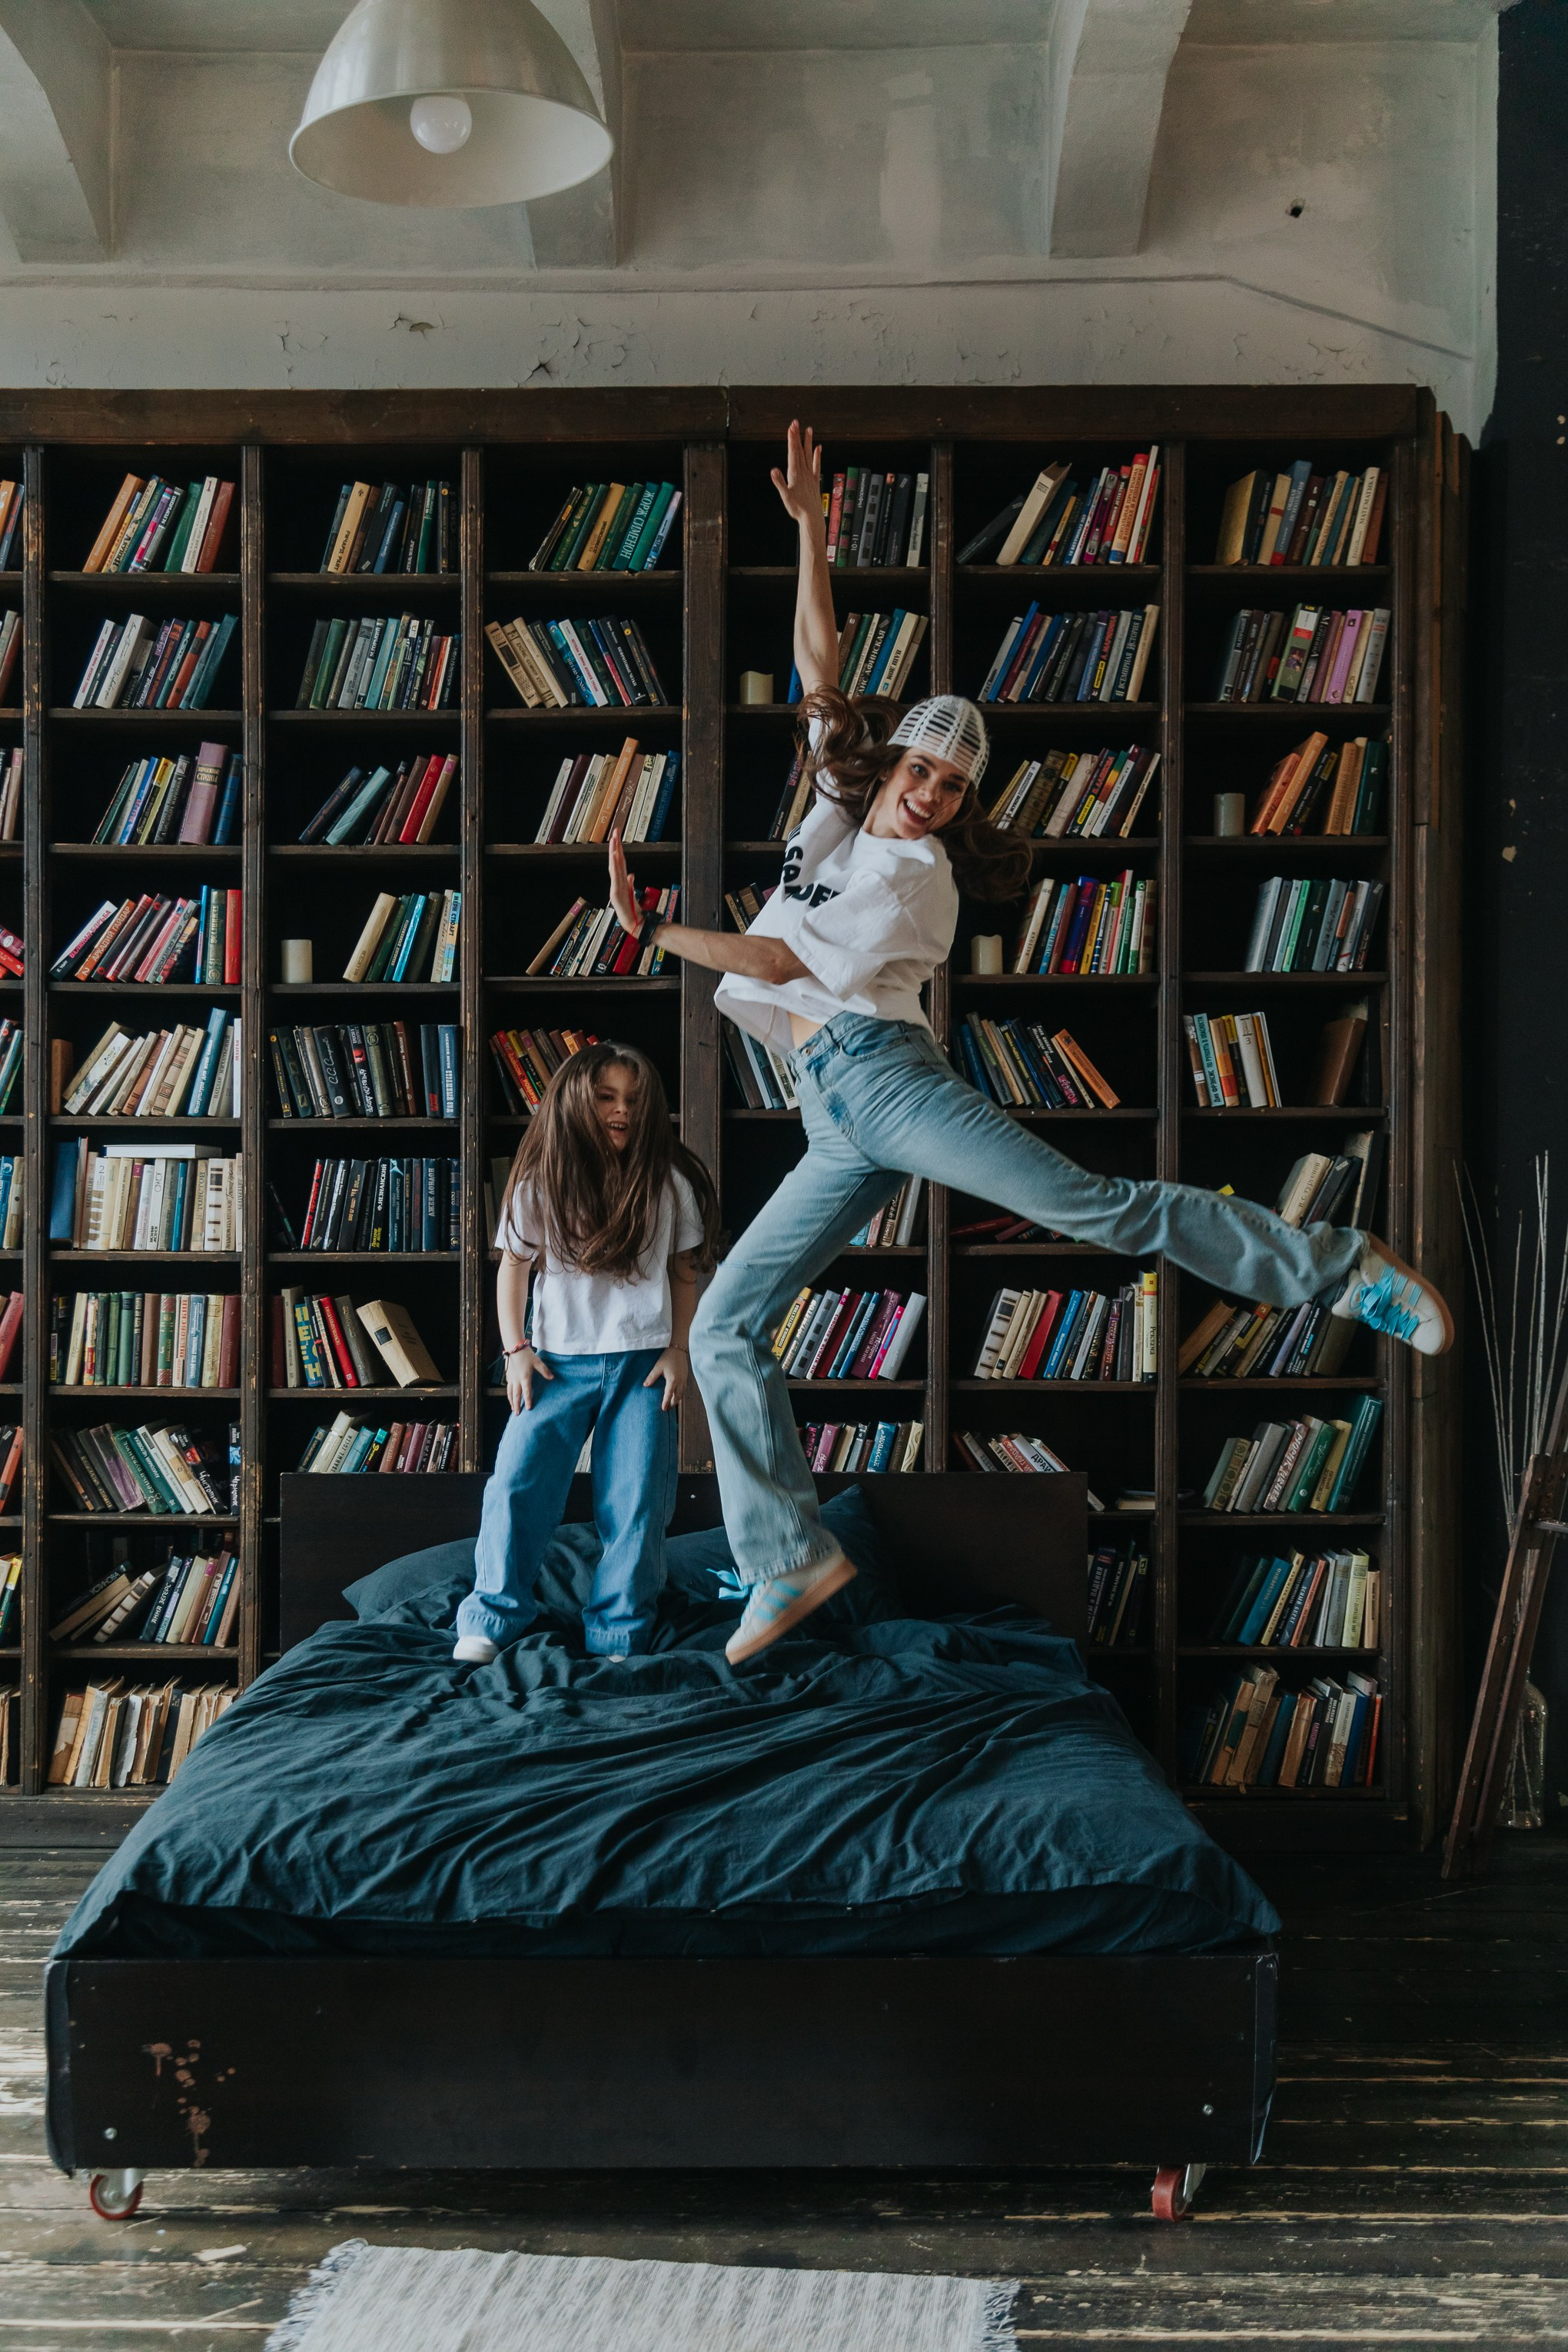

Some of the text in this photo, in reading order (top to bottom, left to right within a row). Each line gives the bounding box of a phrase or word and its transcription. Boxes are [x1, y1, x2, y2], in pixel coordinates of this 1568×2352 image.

[857, 473, 867, 507] Информатика
[1116, 467, 1139, 539] ШКОЛЬНАЯ ПРОГРАММА
[1359, 475, 1375, 524] МАТЕМАТИКА
[619, 489, 655, 559] ЖОРЖ СИМЕНОН
[338, 530, 350, 554] РИЧАРД
[368, 626, 381, 656] М.ГОРЬКИЙ
[1235, 617, 1247, 648] М.ГОРЬКИЙ
[863, 629, 885, 676] АФИНСКАЯ
[885, 649, 901, 679] НАШ ДОМ
[1118, 621, 1140, 689] ВСЕМИРНАЯ ИСТОРИЯ
[535, 676, 546, 689] КУПЕР
[68, 909, 111, 959] ВЕЛИКАЯ БОРЬБА
[90, 905, 131, 962] АРКАДИЙ ГАЙДАР
[447, 913, 457, 936] СТЮАРТ
[1025, 931, 1036, 956] ENGLISH
[1031, 1026, 1045, 1050] Мельницы
[1197, 1015, 1207, 1038] ОПАСНОСТИ
[212, 1034, 231, 1098] ВАЦЛАВ МИХАЛЬСКИЙ
[1202, 1042, 1211, 1061] РУКОЯТЬ
[1208, 1069, 1218, 1092] ФРЭНСИС
[192, 1081, 206, 1113] Физкультура
[1212, 1092, 1221, 1102] Дик
[197, 1171, 205, 1209] ТОЛСТОЙ
[376, 1164, 387, 1211] Ф.НЕЗНАНСКИЙ
[1303, 1161, 1321, 1194] Тургенев
[178, 1298, 188, 1357] ШКЛОВСКИЙ
[777, 1304, 800, 1347] НОВИНКИ ДЕТЕКТИВА
[866, 1335, 882, 1360] История
[133, 1434, 160, 1478] АНАТОМИЯ ЧЕЛОВЕКА
[341, 1434, 353, 1450] ГОСТИ
[872, 1434, 885, 1467] МОПАССАН
[1283, 1432, 1304, 1469] РЮРИК
[89, 1570, 120, 1596] УСТИНОВА
[1090, 1566, 1103, 1596] ПАДЕНИЯ
[151, 1583, 171, 1623] АННА ЗЕГЕРС
[1288, 1606, 1300, 1624] БЕРЕГ
